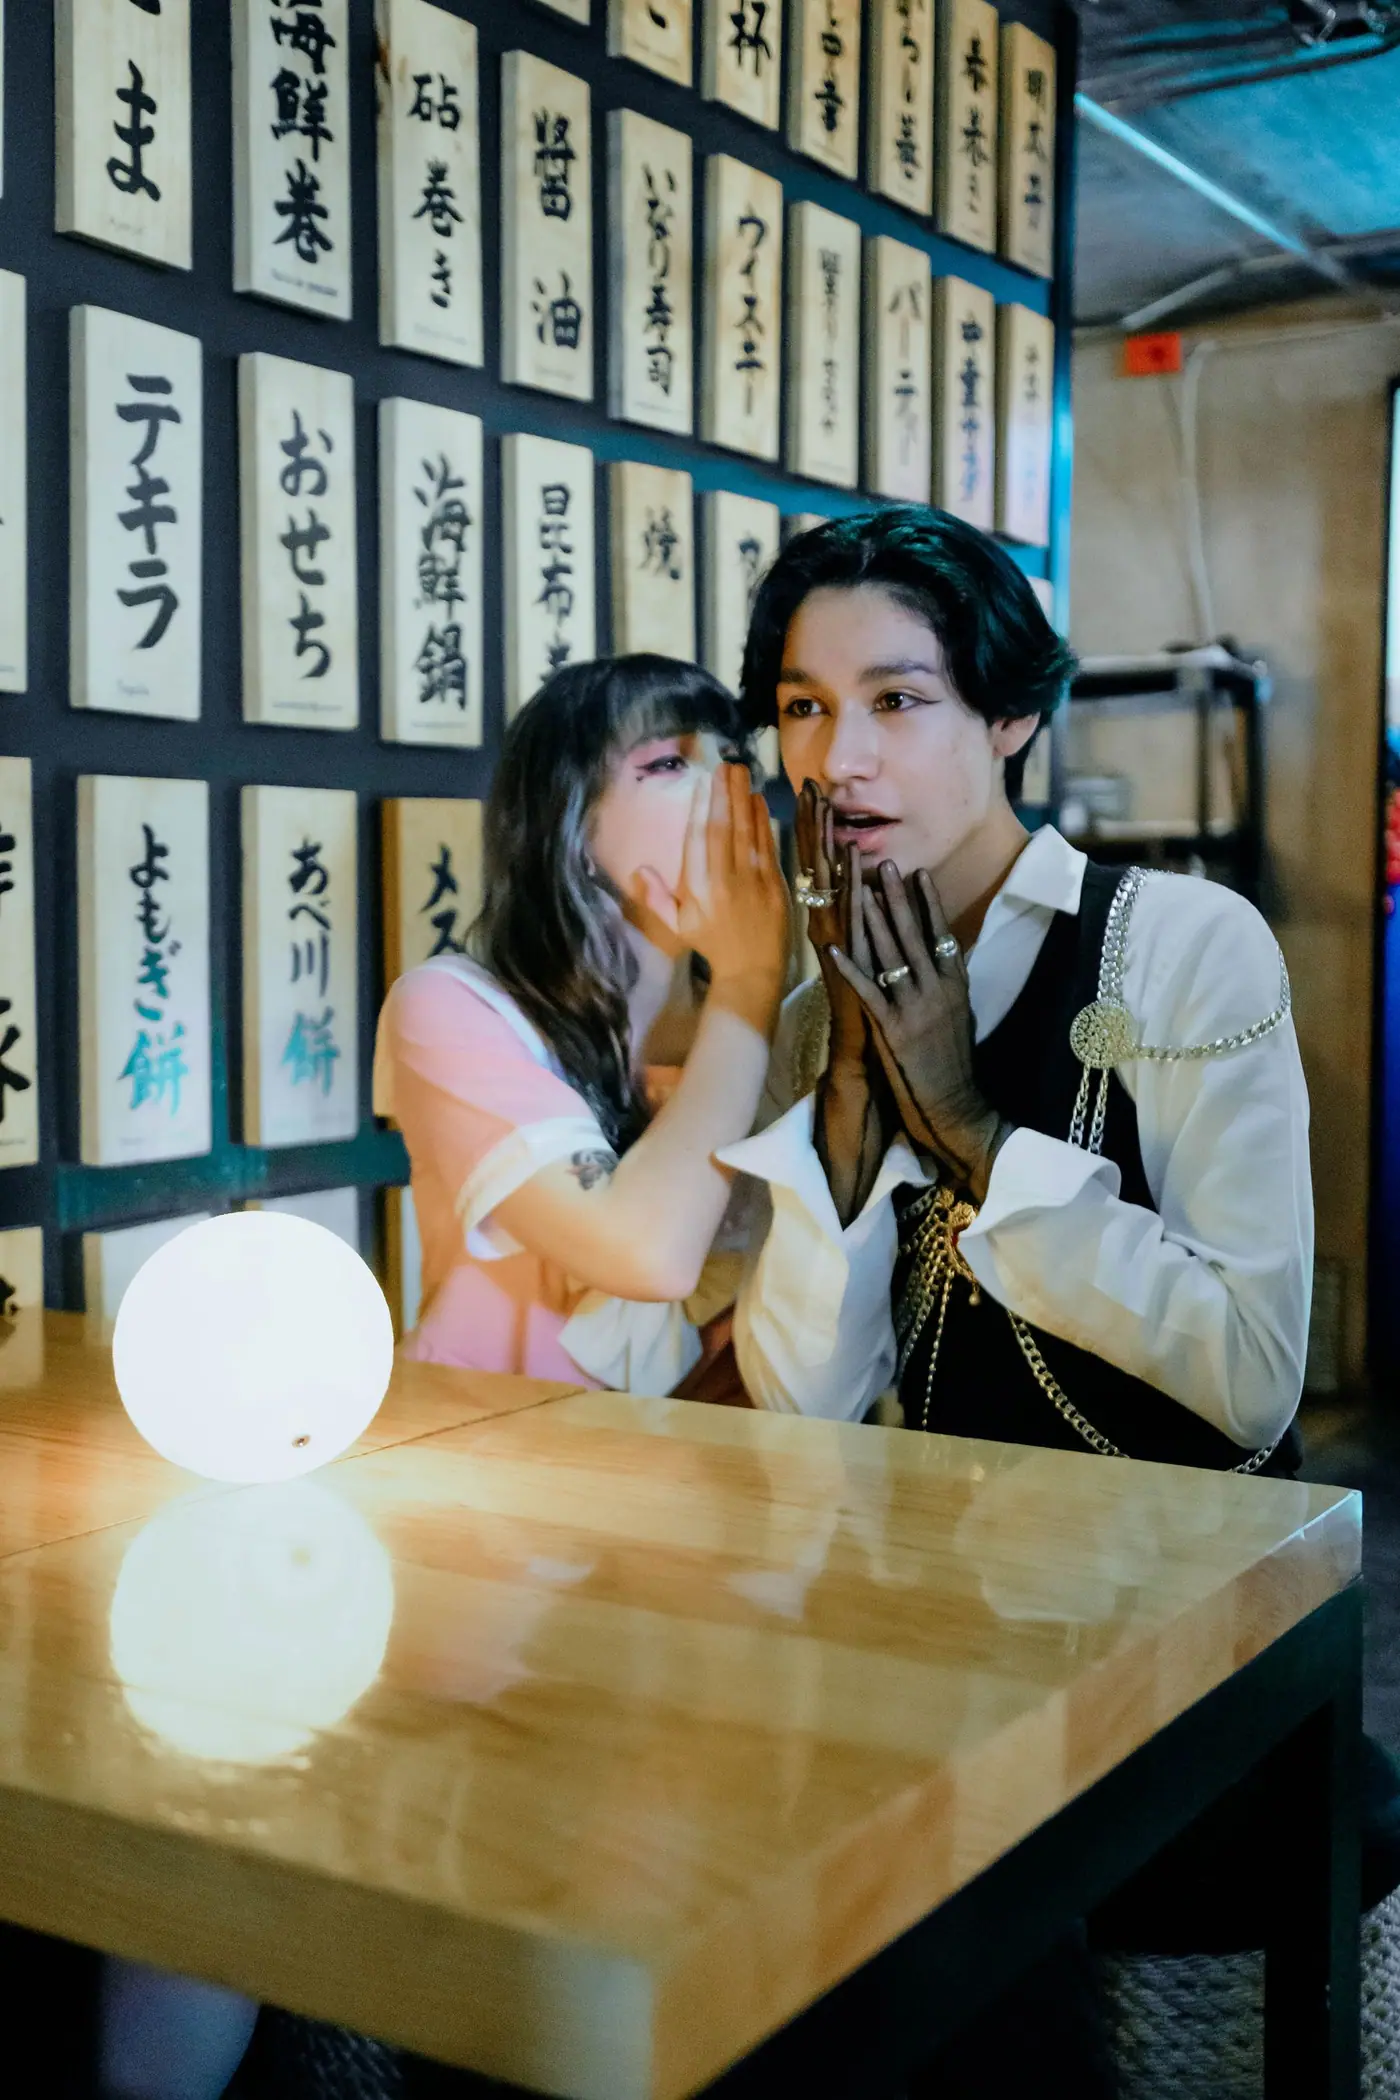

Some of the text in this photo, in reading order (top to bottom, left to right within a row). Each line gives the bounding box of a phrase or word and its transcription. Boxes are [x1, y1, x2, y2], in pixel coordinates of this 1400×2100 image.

[106, 0, 162, 202] ま
[116, 373, 181, 649] テキラ
[280, 409, 332, 678] おせち
[412, 453, 472, 711] 海鮮鍋
[118, 822, 189, 1115] よもぎ餅
[281, 836, 341, 1096] あべ川餅
